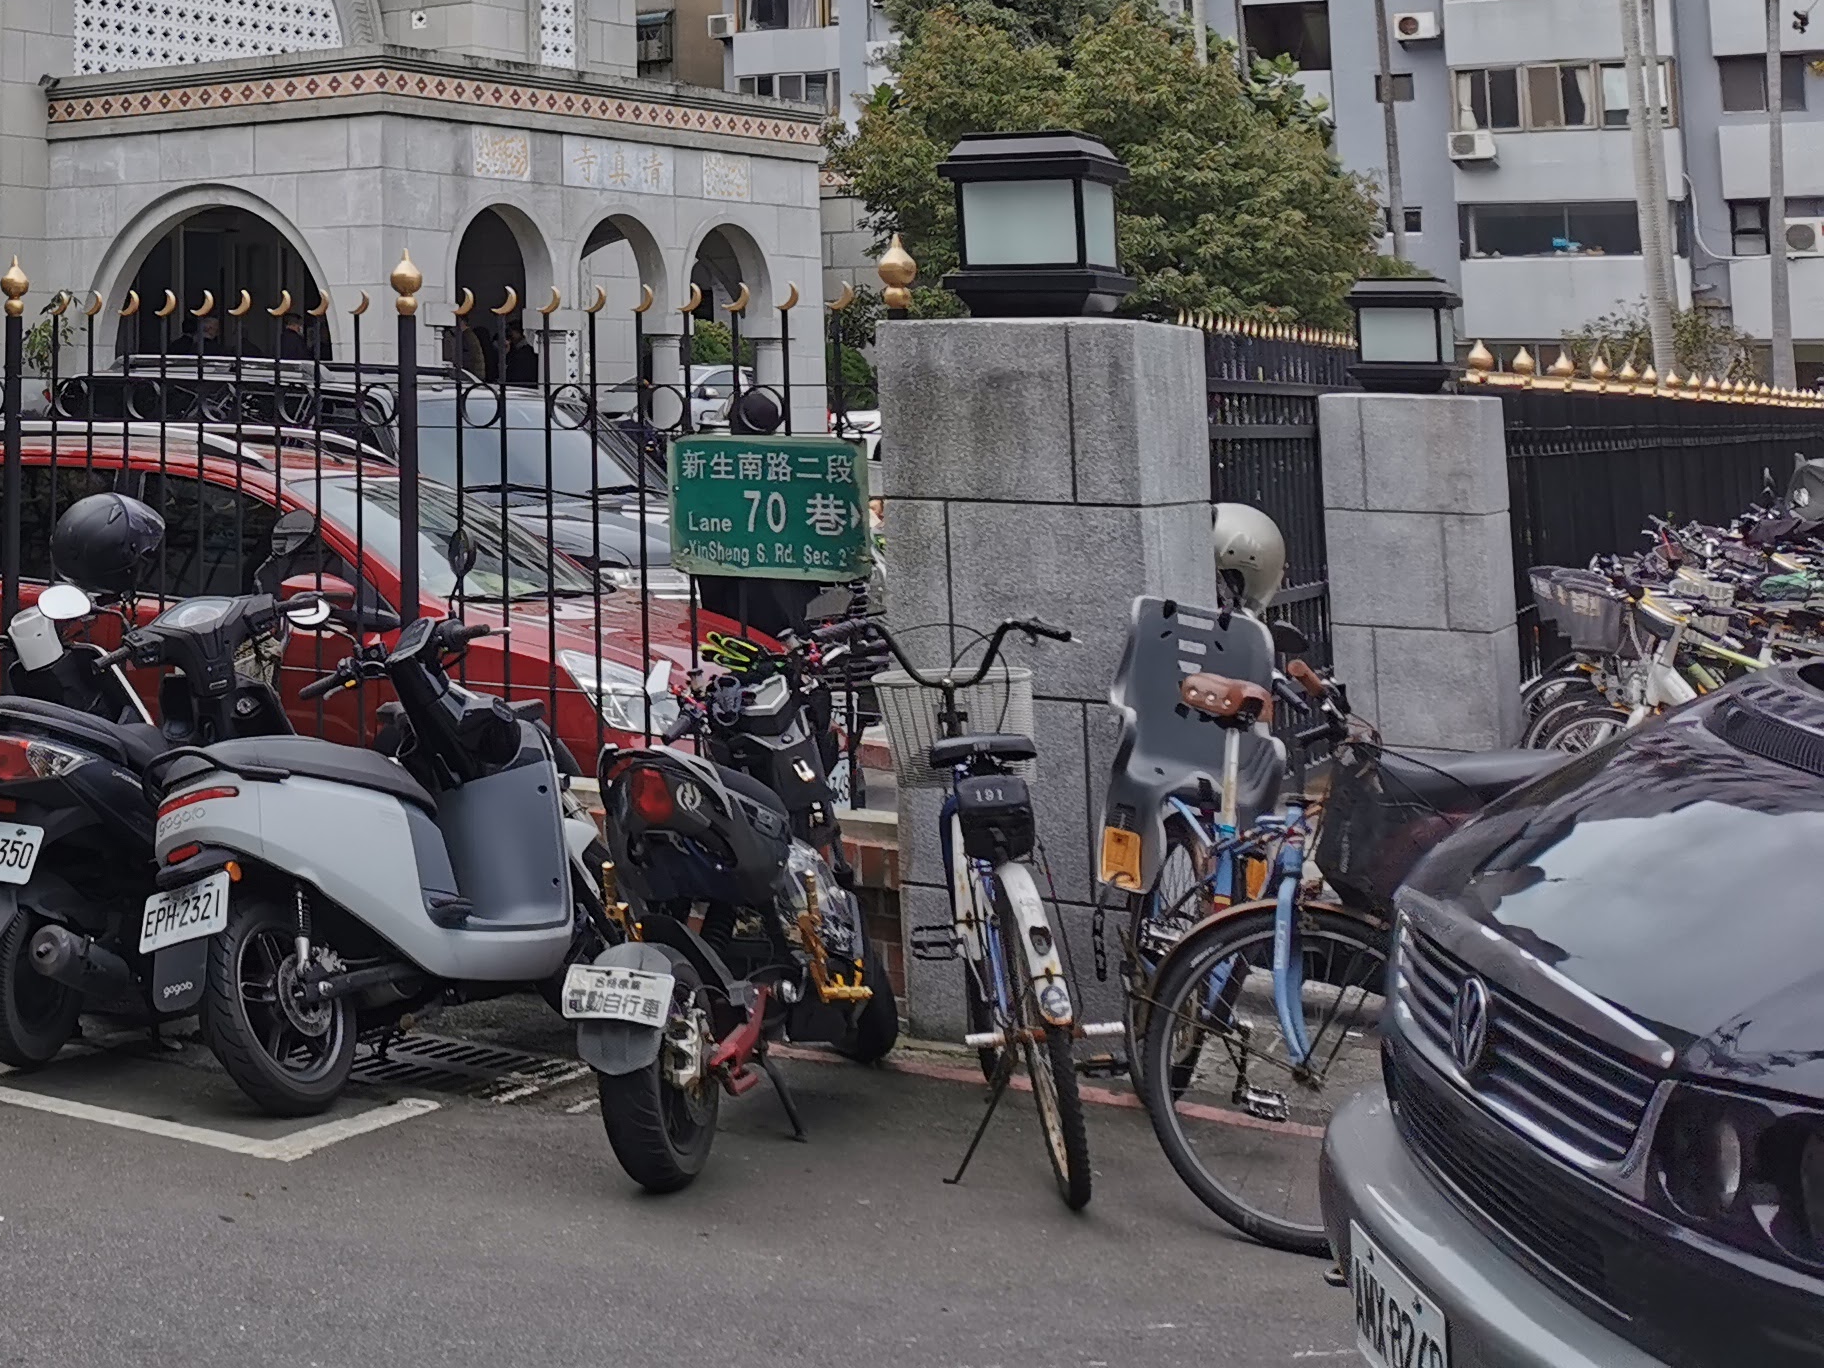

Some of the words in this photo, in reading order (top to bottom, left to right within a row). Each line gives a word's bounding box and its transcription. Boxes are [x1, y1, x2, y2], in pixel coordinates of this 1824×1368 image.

[682, 449, 853, 483] 新生南路二段
[688, 511, 732, 532] Lane
[743, 490, 786, 533] 70
[805, 493, 847, 536] 巷
[688, 540, 750, 566] XinSheng
[756, 543, 769, 563] S.
[976, 788, 1004, 802] 191
[144, 889, 220, 939] EPH-2321
[163, 981, 194, 999] gogoro
[569, 989, 663, 1021] 電動自行車
